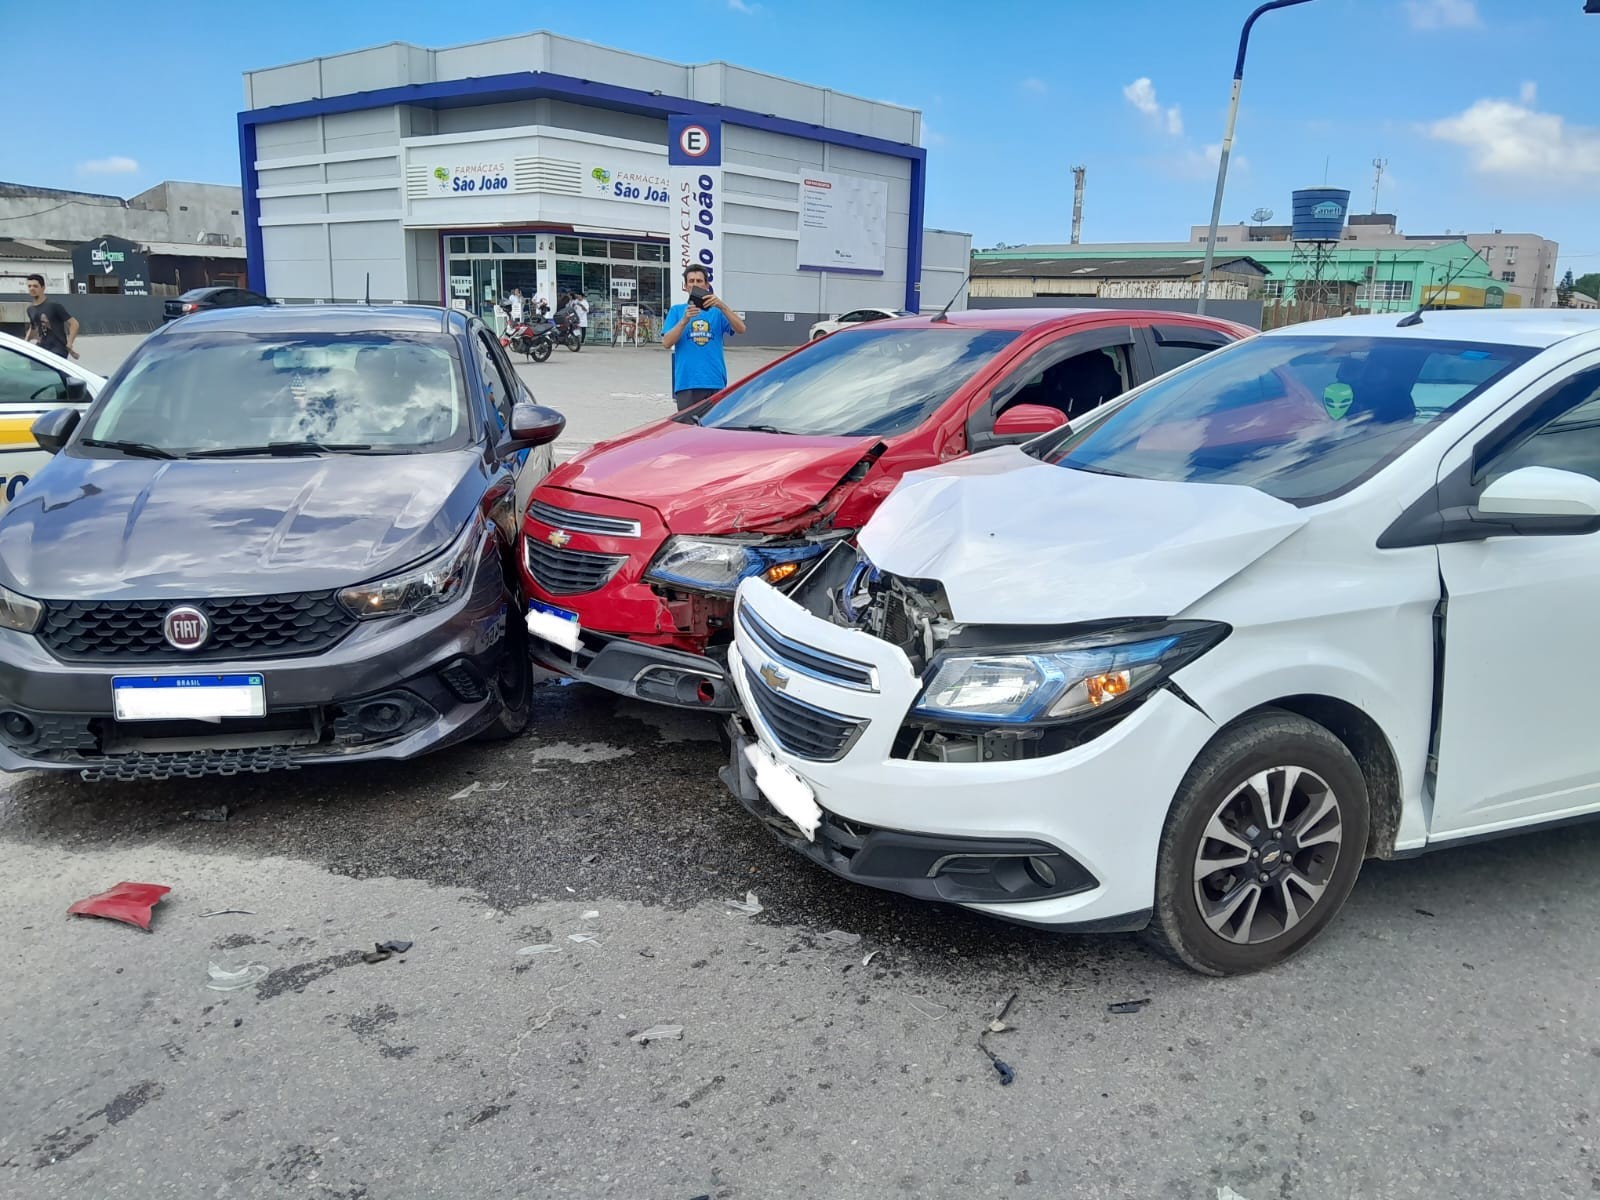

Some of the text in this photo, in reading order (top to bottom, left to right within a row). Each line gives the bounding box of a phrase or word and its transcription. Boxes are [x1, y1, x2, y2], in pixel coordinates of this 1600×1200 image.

[687, 131, 702, 151] E
[455, 162, 505, 174] FARMÁCIAS
[452, 173, 508, 192] São João
[613, 182, 670, 203] São Joã
[693, 174, 714, 241] João
[680, 182, 691, 292] FRMÁCIAS
[173, 619, 199, 639] FIAT
[176, 679, 201, 687] BRASIL
